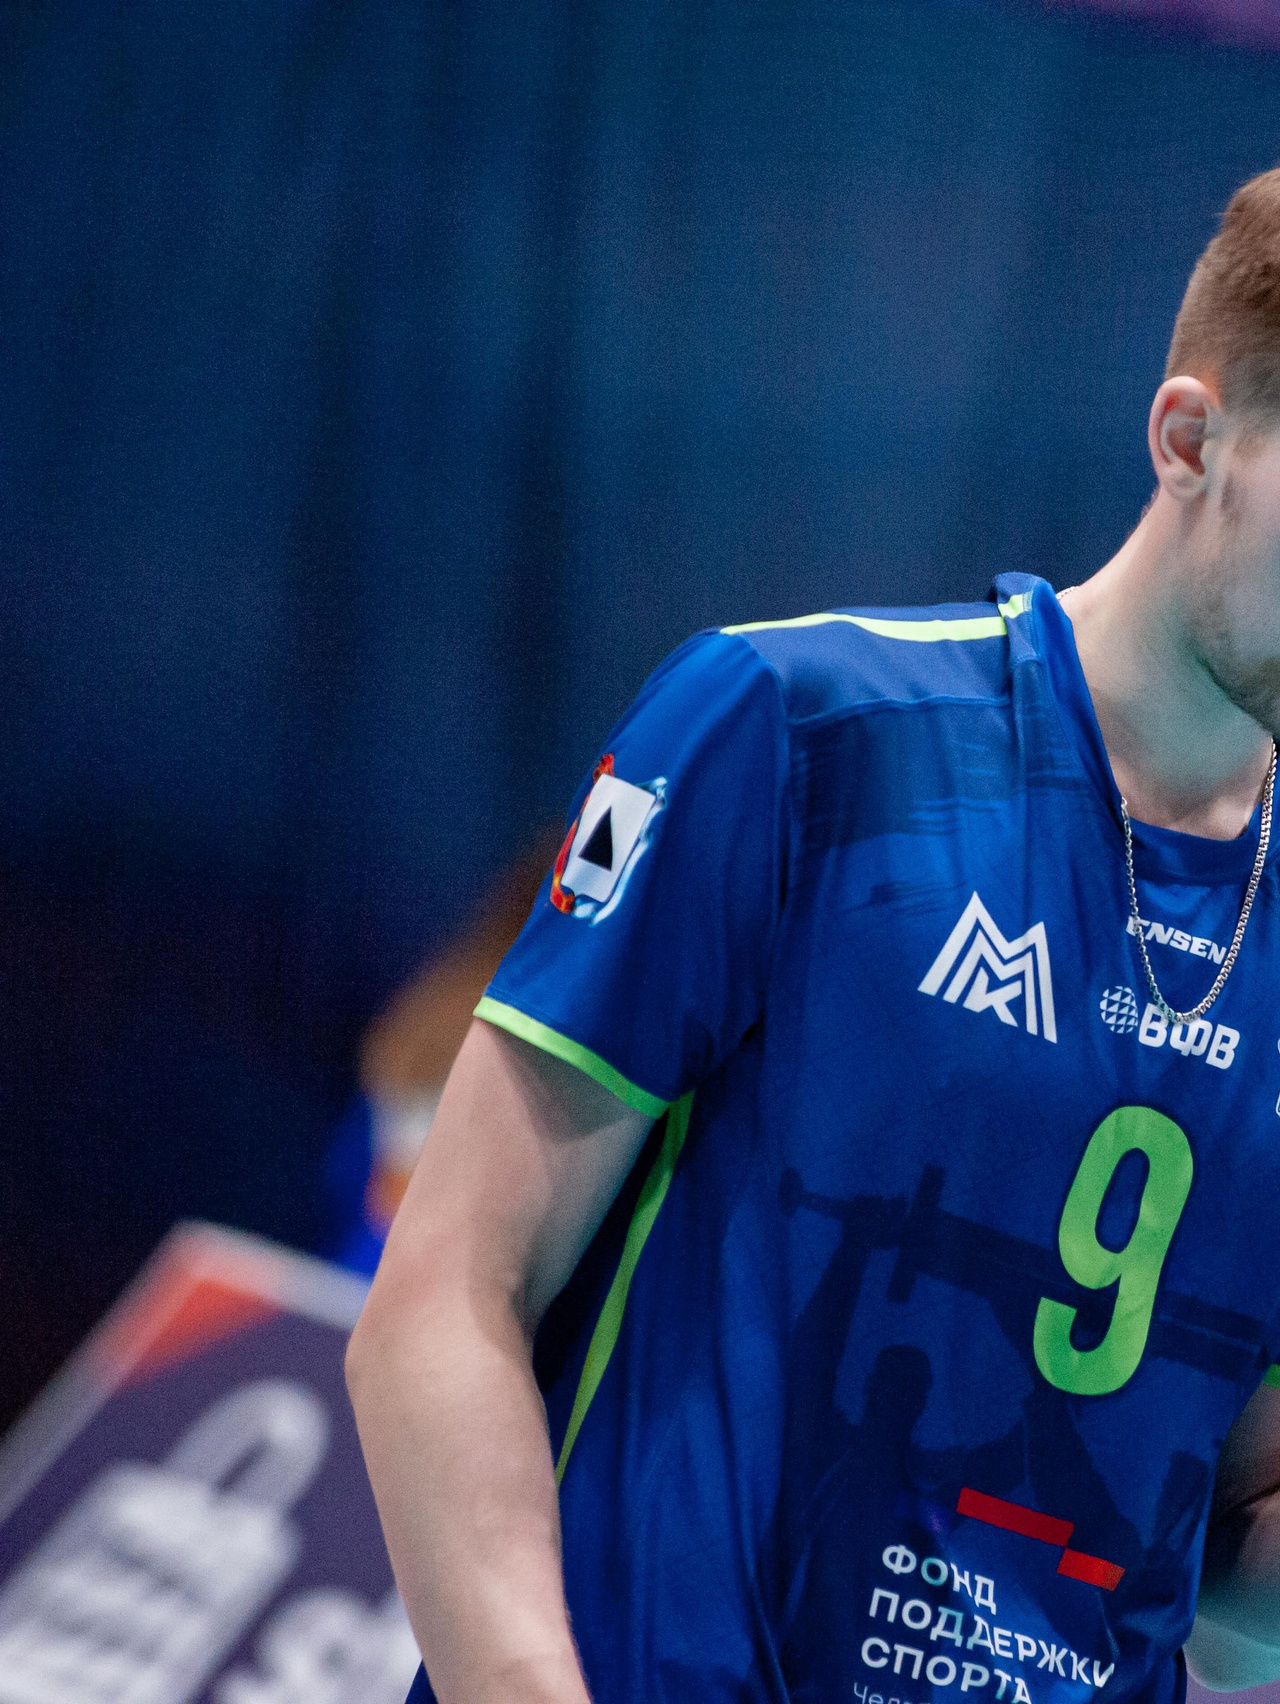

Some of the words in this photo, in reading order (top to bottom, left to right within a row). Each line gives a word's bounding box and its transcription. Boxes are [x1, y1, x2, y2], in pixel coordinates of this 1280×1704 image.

[1138, 1003, 1240, 1070] ВФВ
[1033, 1105, 1194, 1396] 9
[882, 1544, 996, 1615] ФОНД
[861, 1637, 1032, 1704] СПОРТА
